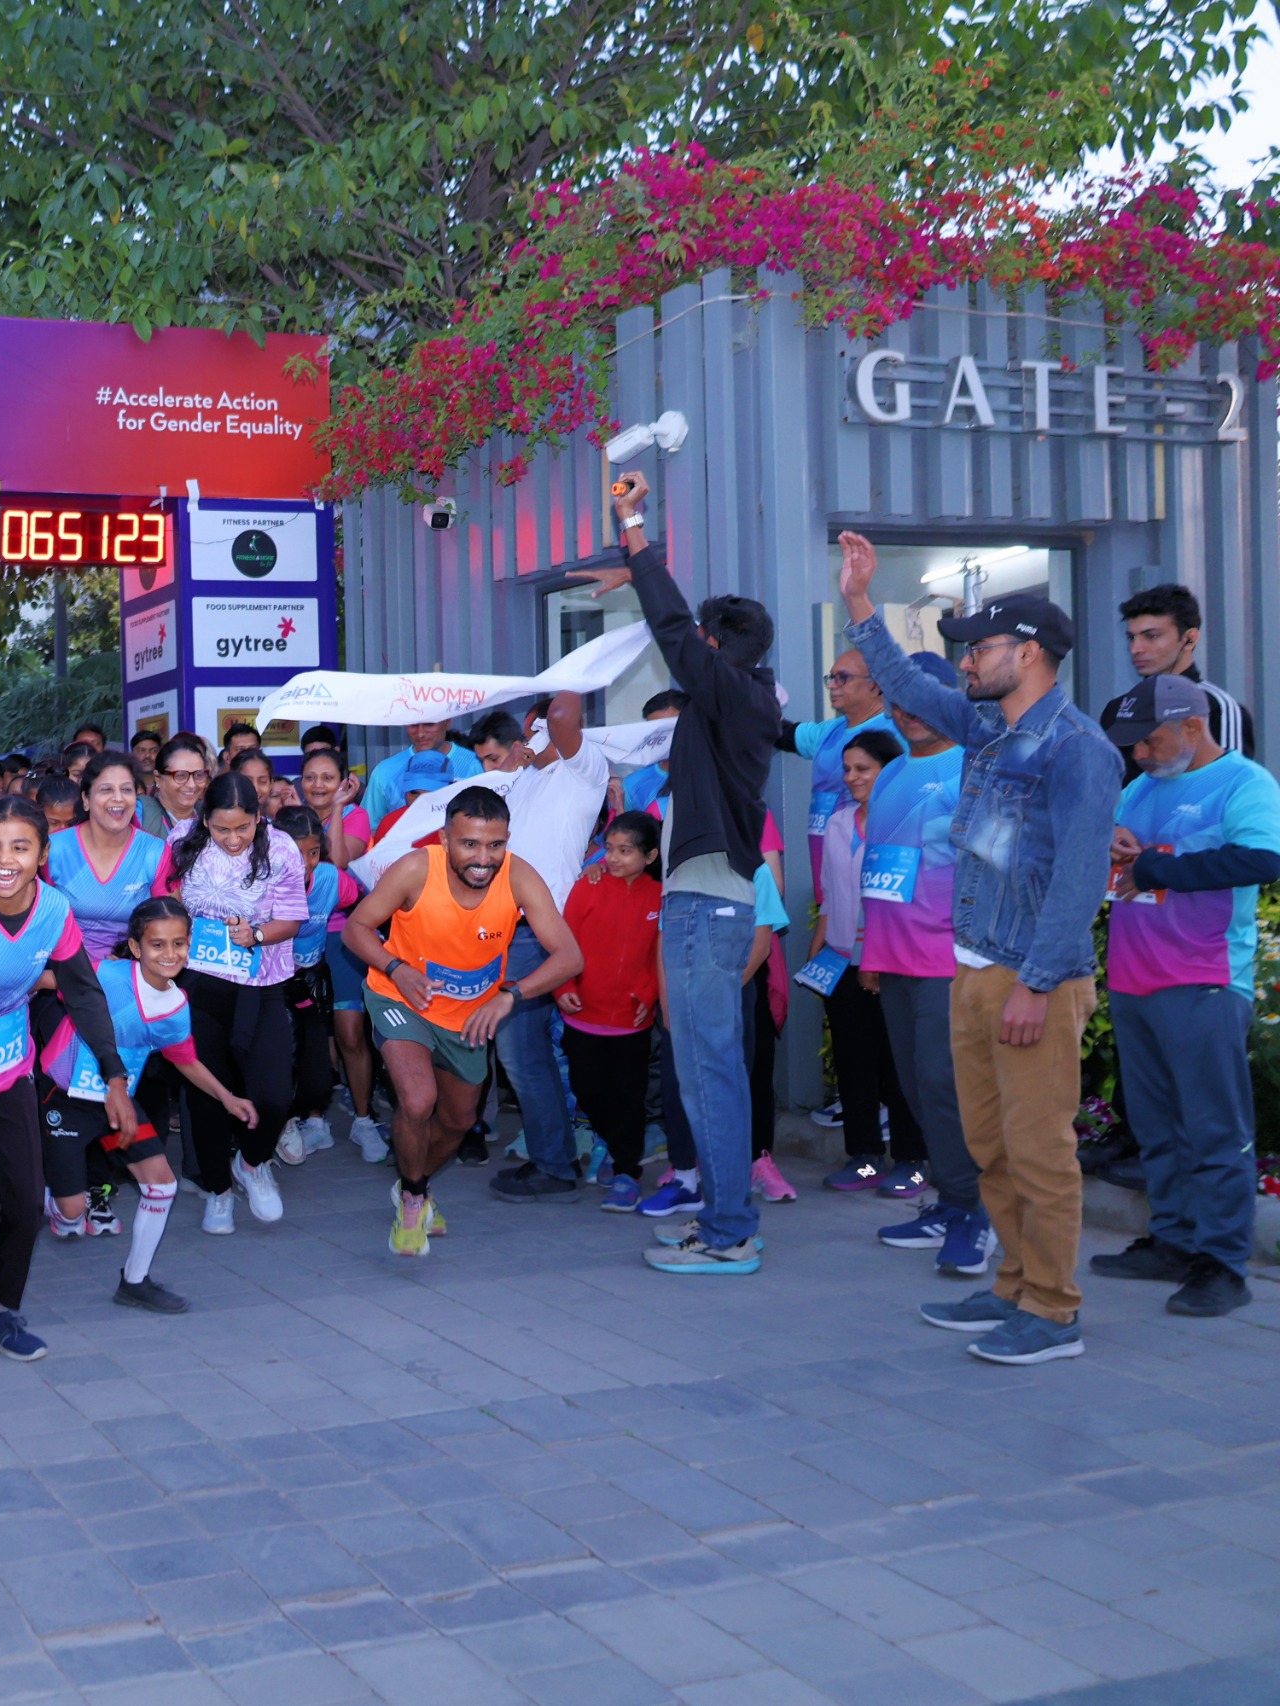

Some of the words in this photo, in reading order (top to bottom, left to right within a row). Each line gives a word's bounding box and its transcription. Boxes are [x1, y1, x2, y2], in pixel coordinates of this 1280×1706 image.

[95, 386, 213, 409] #Accelerate
[217, 391, 279, 411] Action
[117, 409, 145, 430] for
[150, 412, 221, 433] Gender
[226, 414, 303, 440] Equality
[222, 518, 250, 526] FITNESS
[253, 519, 285, 527] PARTNER
[216, 635, 288, 657] gytree
[134, 645, 163, 671] gytree
[412, 685, 486, 705] WOMEN
[196, 945, 253, 968] 50495
[435, 977, 490, 995] 0515
